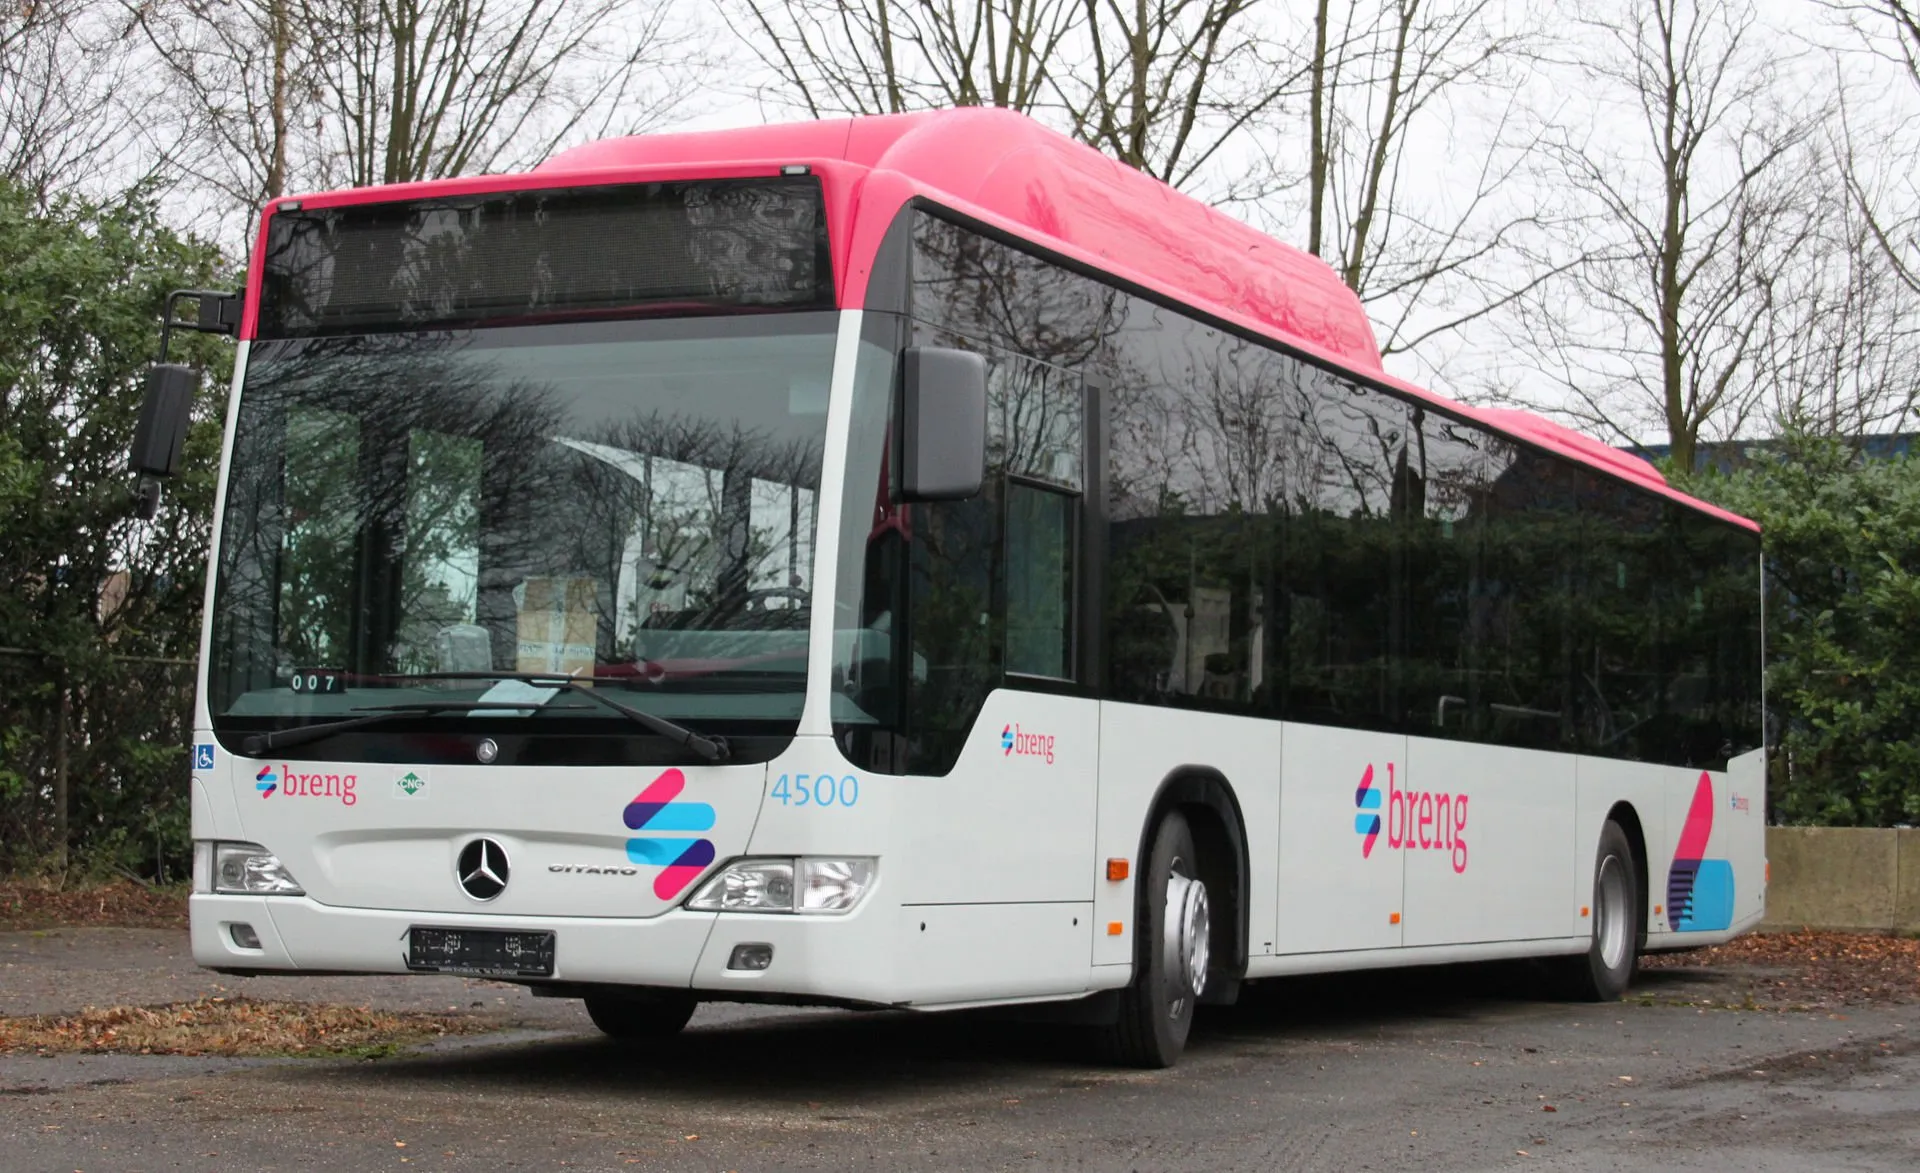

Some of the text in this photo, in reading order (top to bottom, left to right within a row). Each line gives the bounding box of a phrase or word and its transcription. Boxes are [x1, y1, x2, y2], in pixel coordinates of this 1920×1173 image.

[1015, 723, 1055, 765] breng
[282, 763, 358, 806] breng
[399, 778, 424, 789] CNG
[770, 773, 860, 808] 4500
[1387, 761, 1470, 874] breng
[548, 863, 638, 876] CITARO
